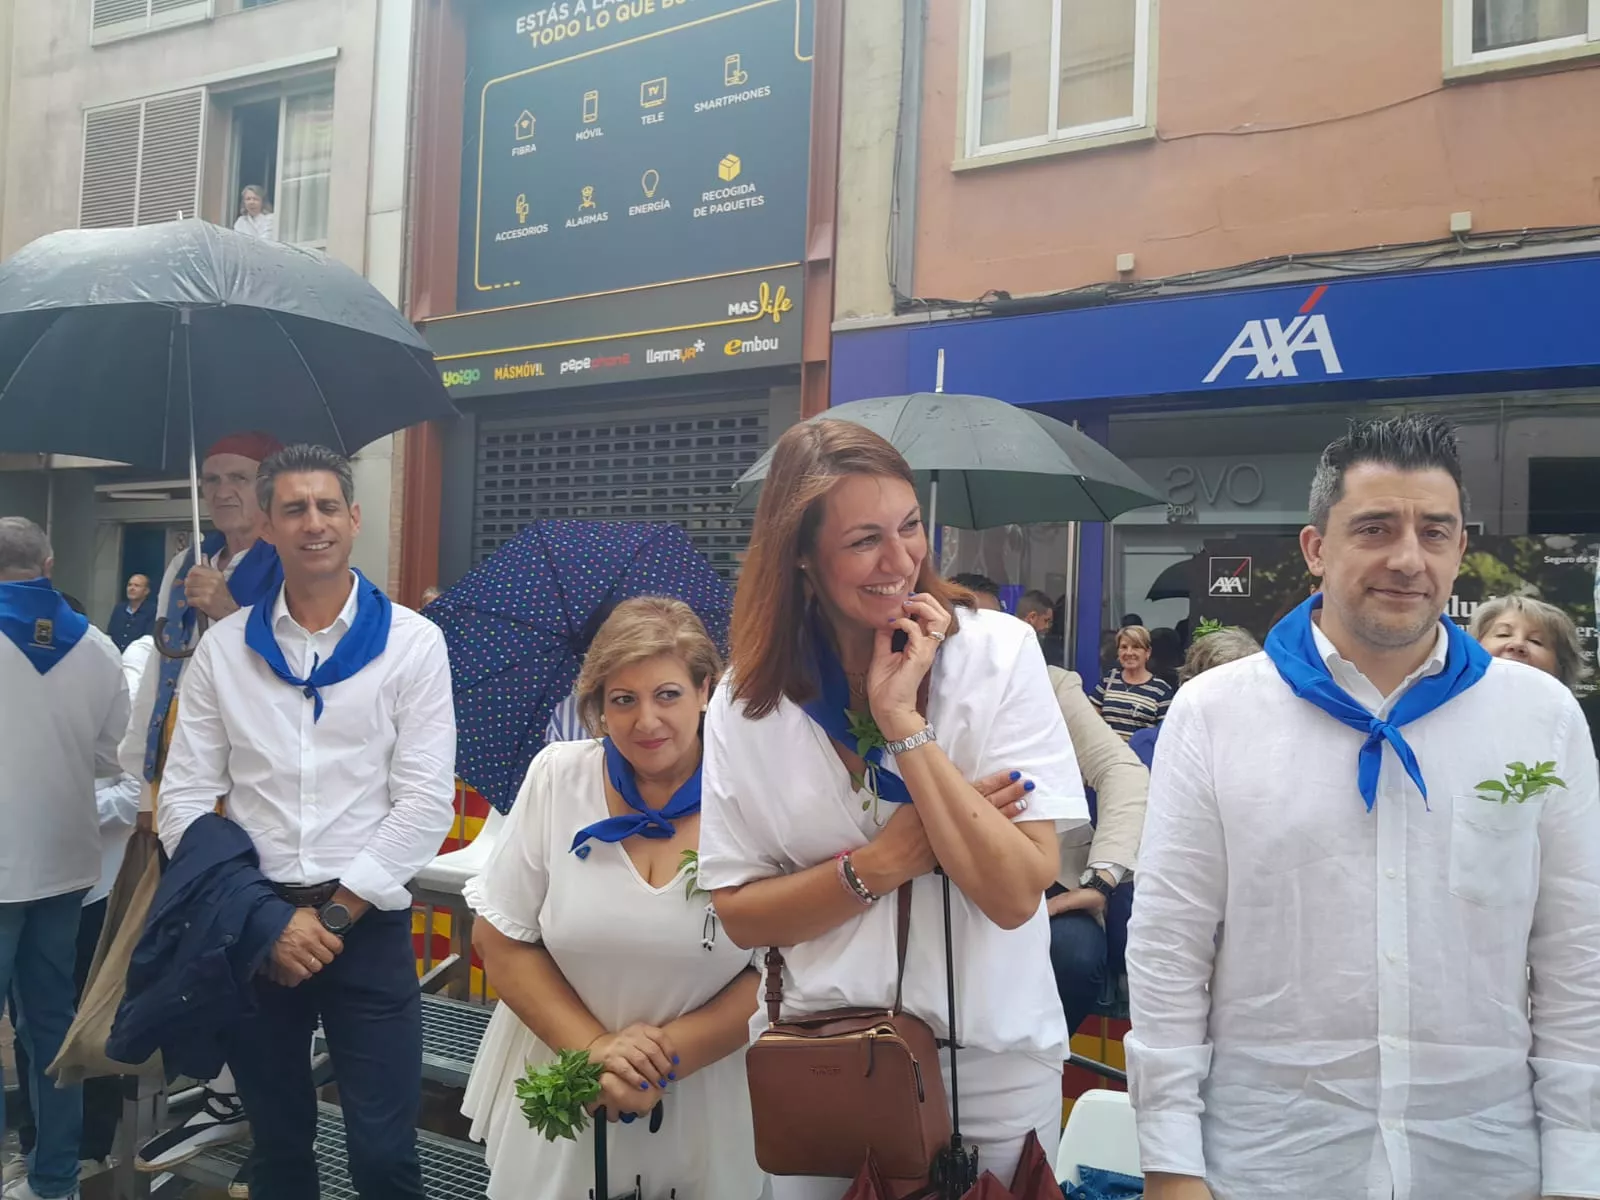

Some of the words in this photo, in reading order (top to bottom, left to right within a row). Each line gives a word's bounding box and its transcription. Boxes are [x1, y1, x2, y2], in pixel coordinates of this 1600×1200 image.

[516, 2, 569, 34] ESTÁS
[574, 1, 587, 16] A
[530, 20, 581, 48] TODO
[585, 10, 610, 32] LO
[615, 1, 656, 22] QUE
[693, 85, 772, 113] SMARTPHONES
[640, 111, 665, 126] TELE
[575, 127, 604, 141] MÓVIL
[511, 143, 537, 156] FIBRA
[702, 183, 756, 202] RECOGIDA
[628, 198, 671, 216] ENERGÍA
[693, 206, 708, 218] DE
[709, 195, 765, 215] PAQUETES
[564, 211, 609, 228] ALARMAS
[494, 223, 549, 242] ACCESORIOS
[724, 336, 779, 356] embou
[1201, 313, 1344, 383] AXA
[1543, 555, 1576, 565] Seguro
[1208, 576, 1244, 594] AXA
